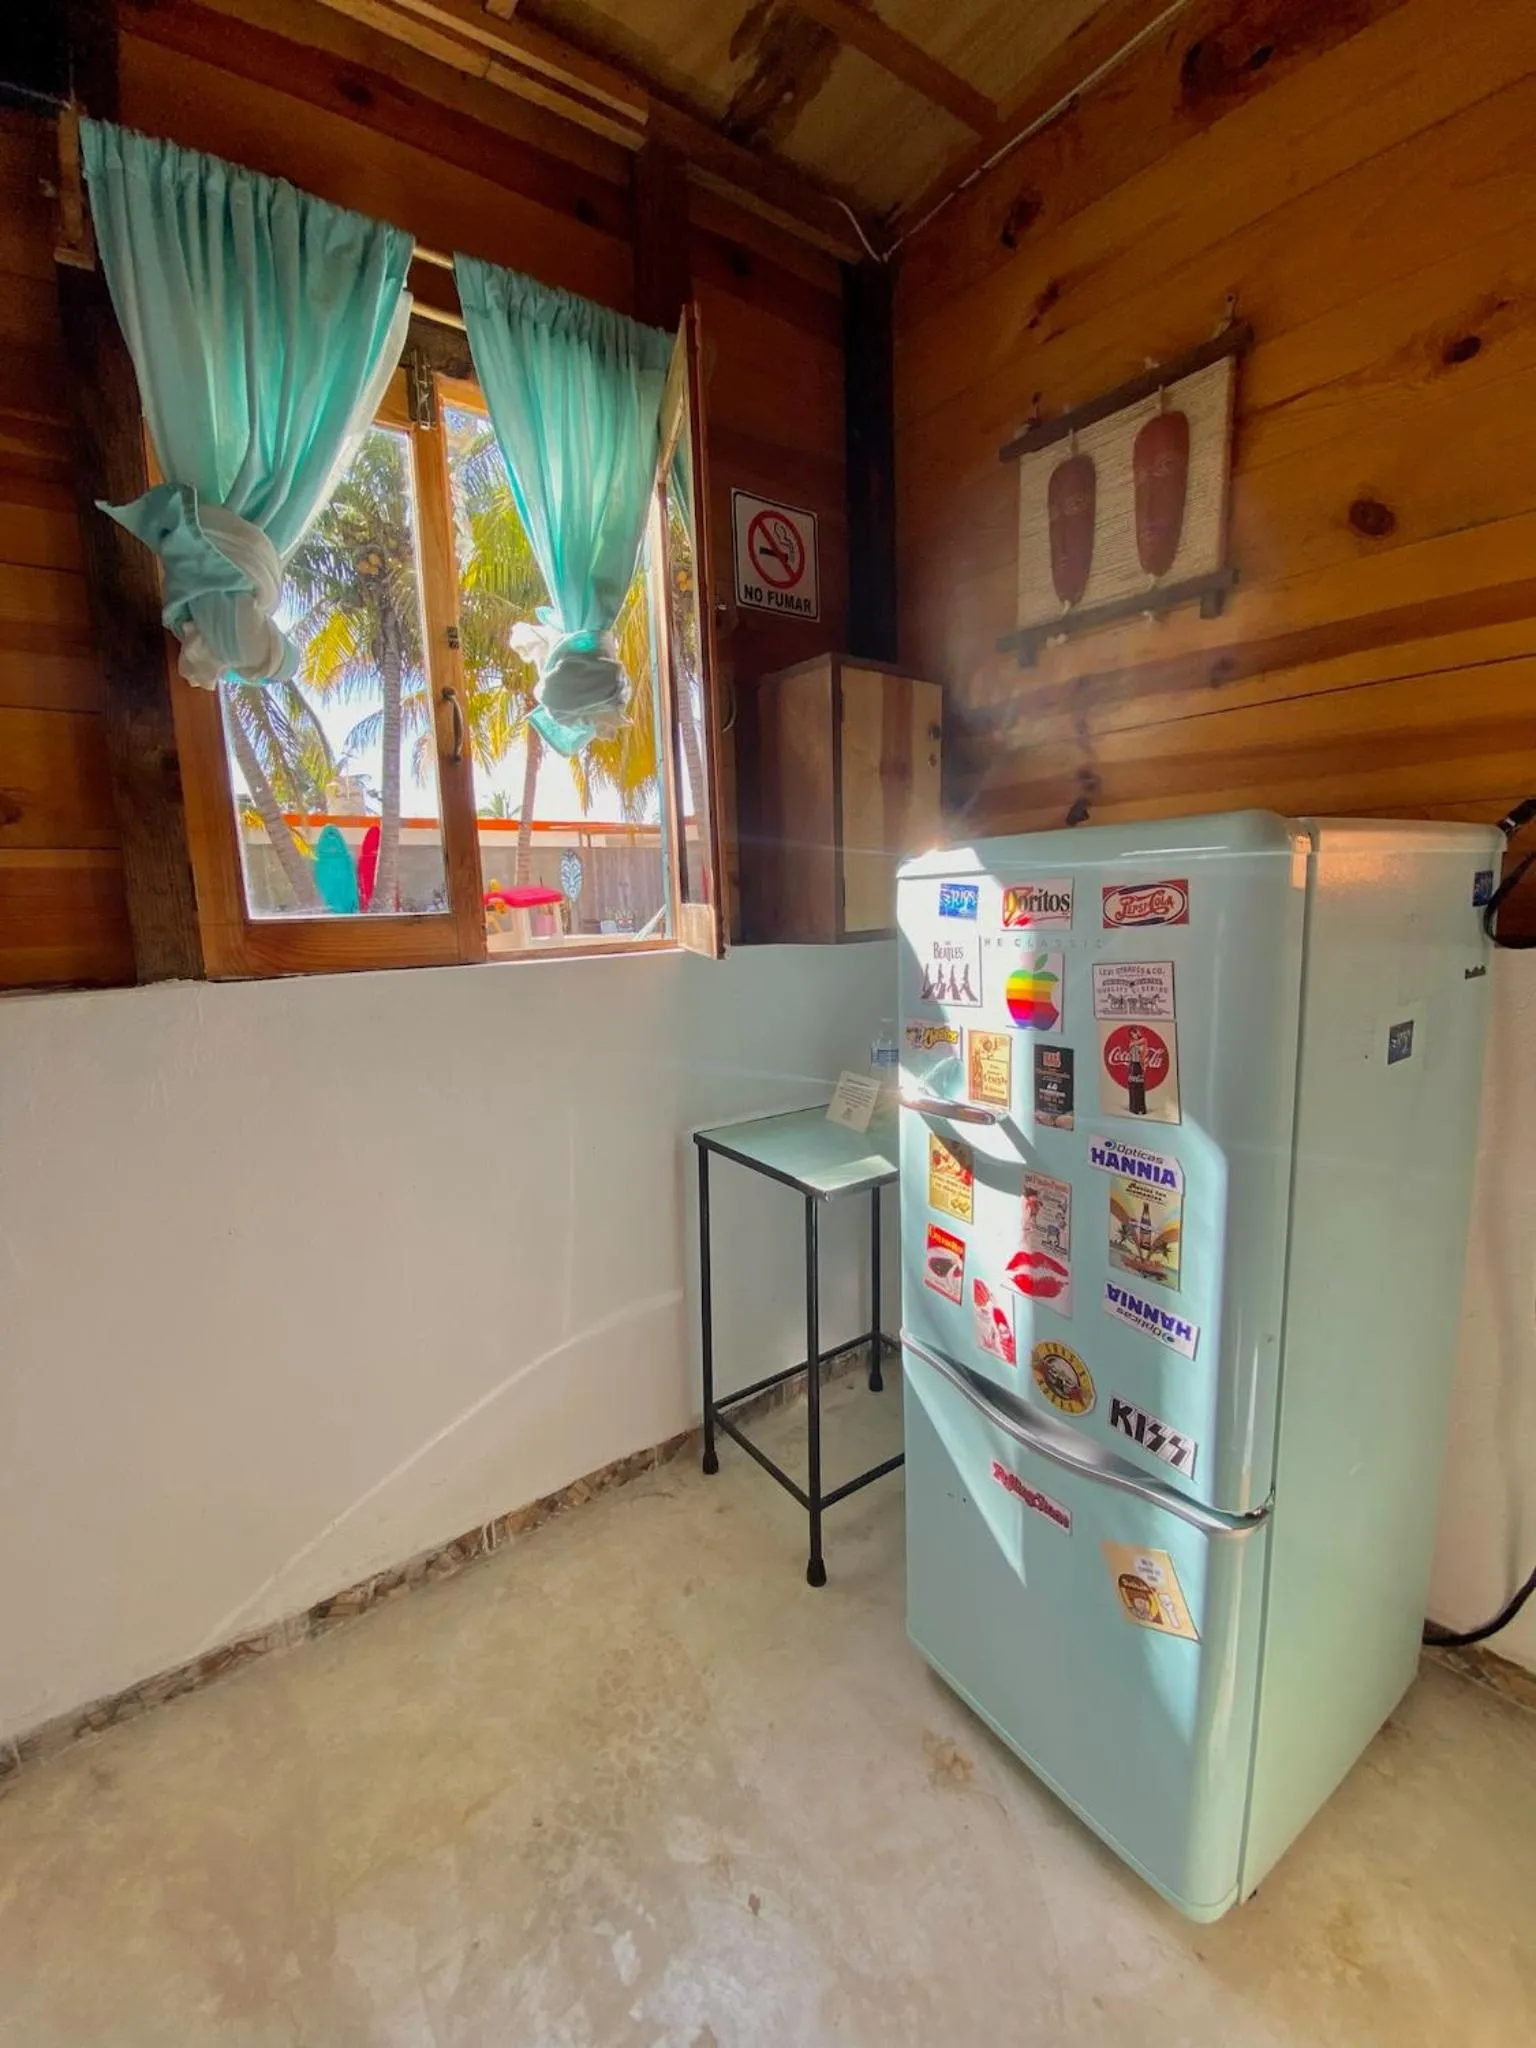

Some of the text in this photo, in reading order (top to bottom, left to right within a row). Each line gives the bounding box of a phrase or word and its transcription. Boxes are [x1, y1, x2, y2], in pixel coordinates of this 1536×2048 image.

[743, 584, 812, 613] NO FUMAR
[1003, 886, 1071, 927] Doritos
[1091, 1147, 1177, 1188] HANNIA
[1106, 1283, 1192, 1341] HANNIA
[1111, 1397, 1188, 1466] KISS
